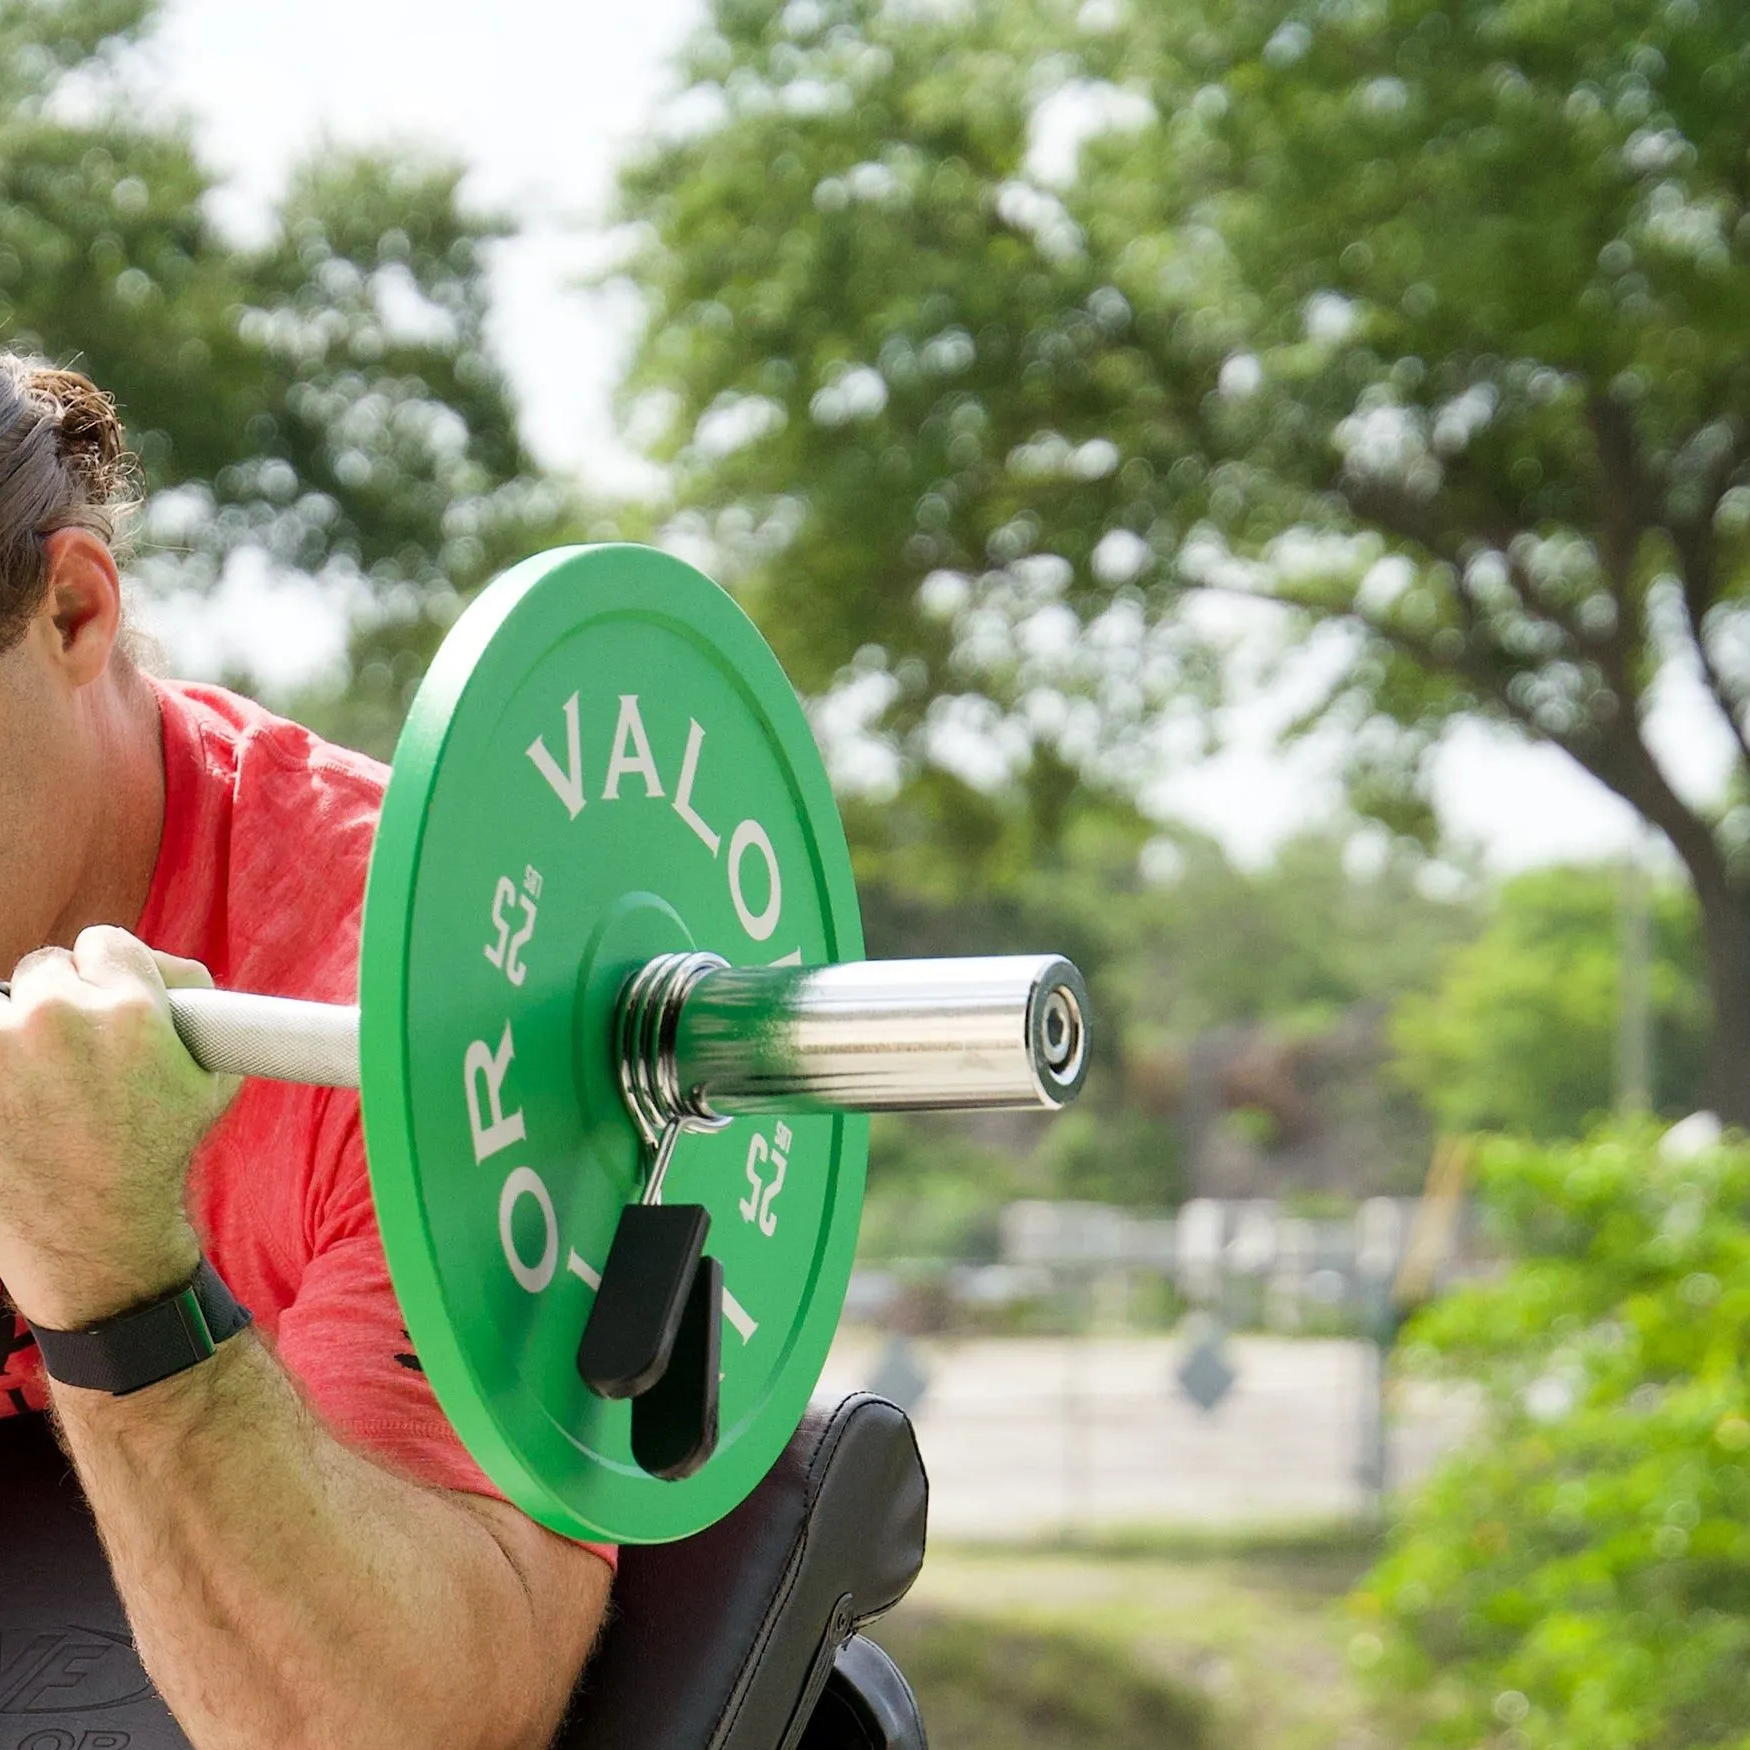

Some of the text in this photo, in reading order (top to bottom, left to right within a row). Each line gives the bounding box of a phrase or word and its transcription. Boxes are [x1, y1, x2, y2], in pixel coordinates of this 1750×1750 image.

[526, 689, 802, 968] VALO
[482, 875, 537, 986] 25
[739, 1133, 787, 1237] 25
